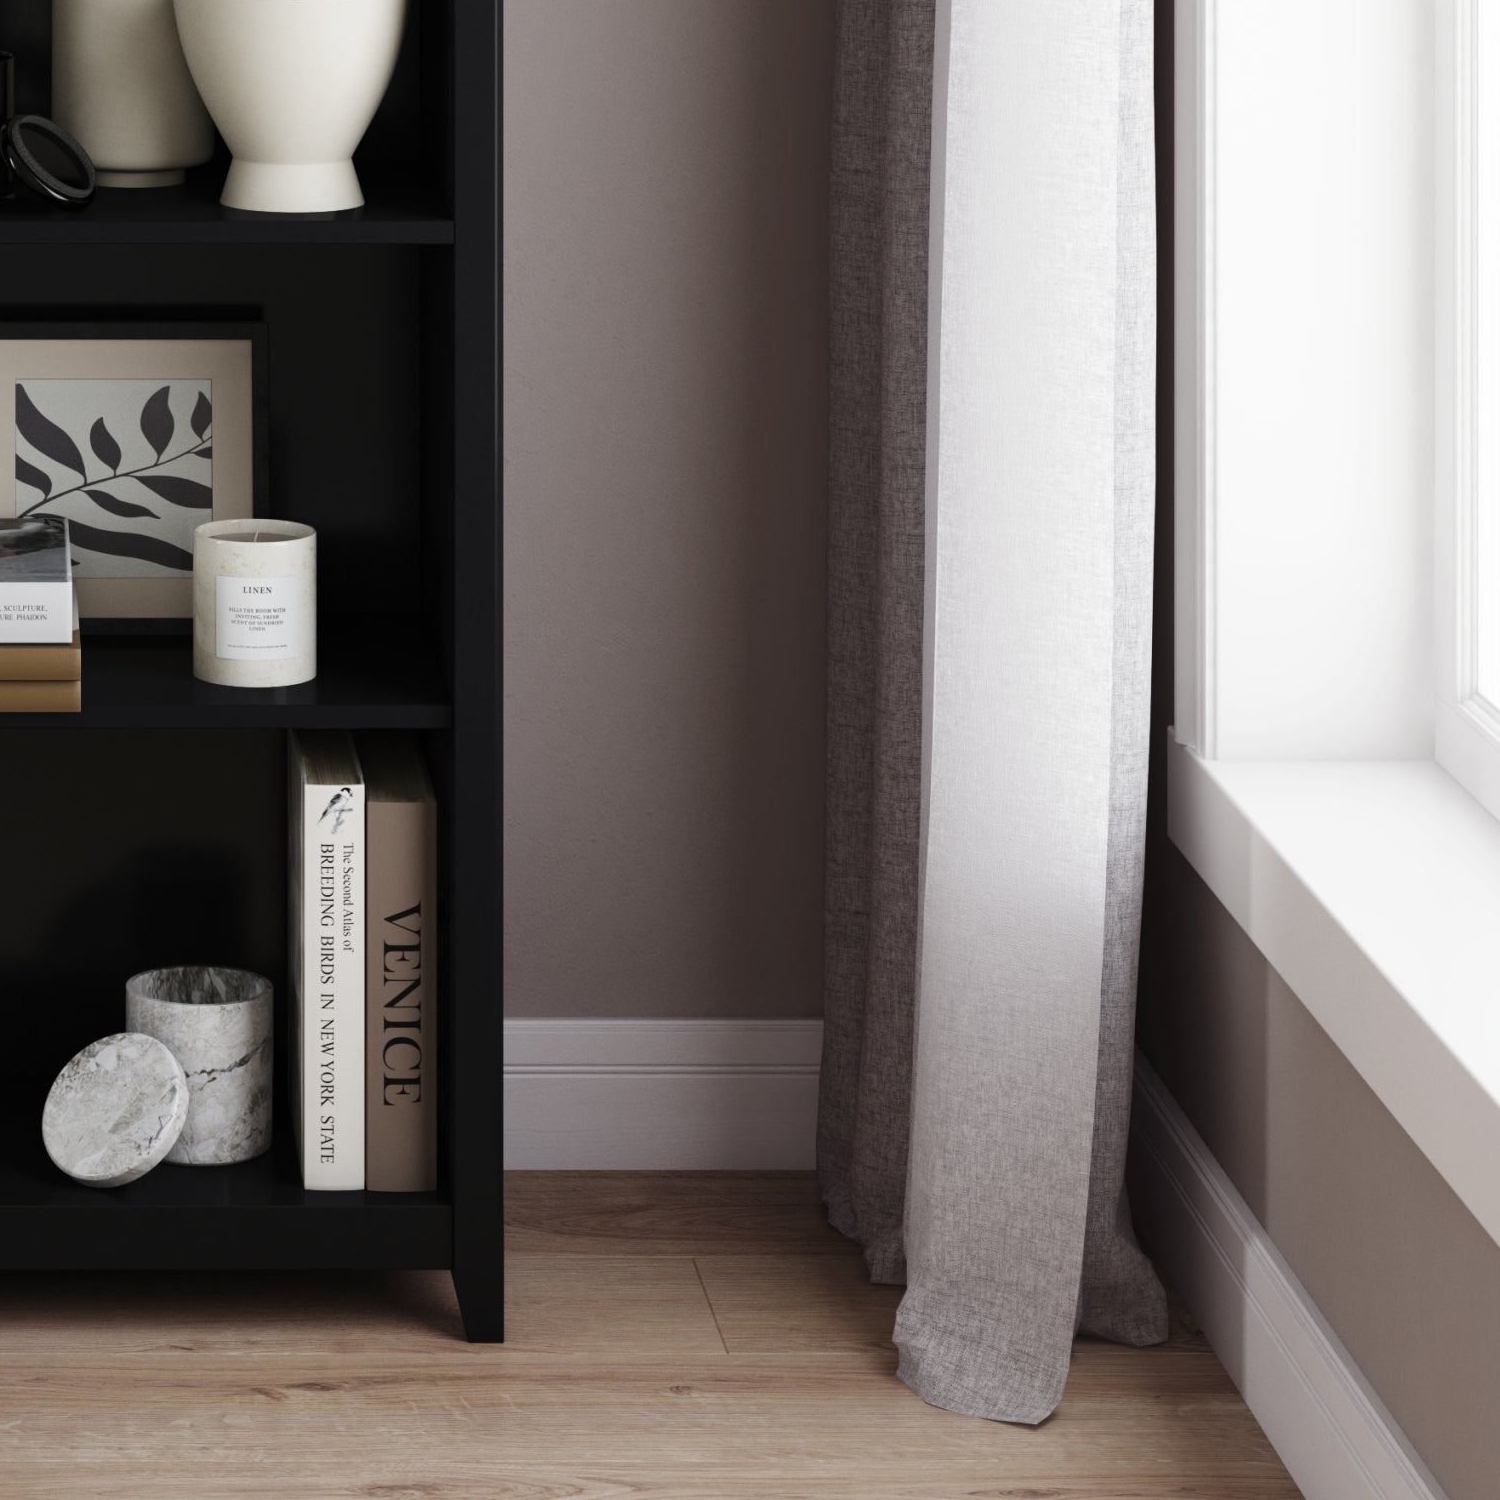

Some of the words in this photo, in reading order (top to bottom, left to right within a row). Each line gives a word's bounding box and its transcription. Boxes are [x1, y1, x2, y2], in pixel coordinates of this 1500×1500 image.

[243, 586, 272, 594] LINEN
[3, 604, 48, 612] SCULPTURE,
[16, 613, 48, 621] PHAIDON
[342, 842, 355, 864] The
[320, 843, 335, 927] BREEDING
[342, 866, 355, 906] Second
[342, 908, 355, 937] Atlas
[320, 936, 335, 985] BIRDS
[342, 939, 355, 953] of
[320, 993, 335, 1010] IN
[382, 900, 422, 1106] VENICE
[320, 1019, 335, 1056] NEW
[320, 1060, 335, 1107] YORK
[320, 1115, 335, 1164] STATE
